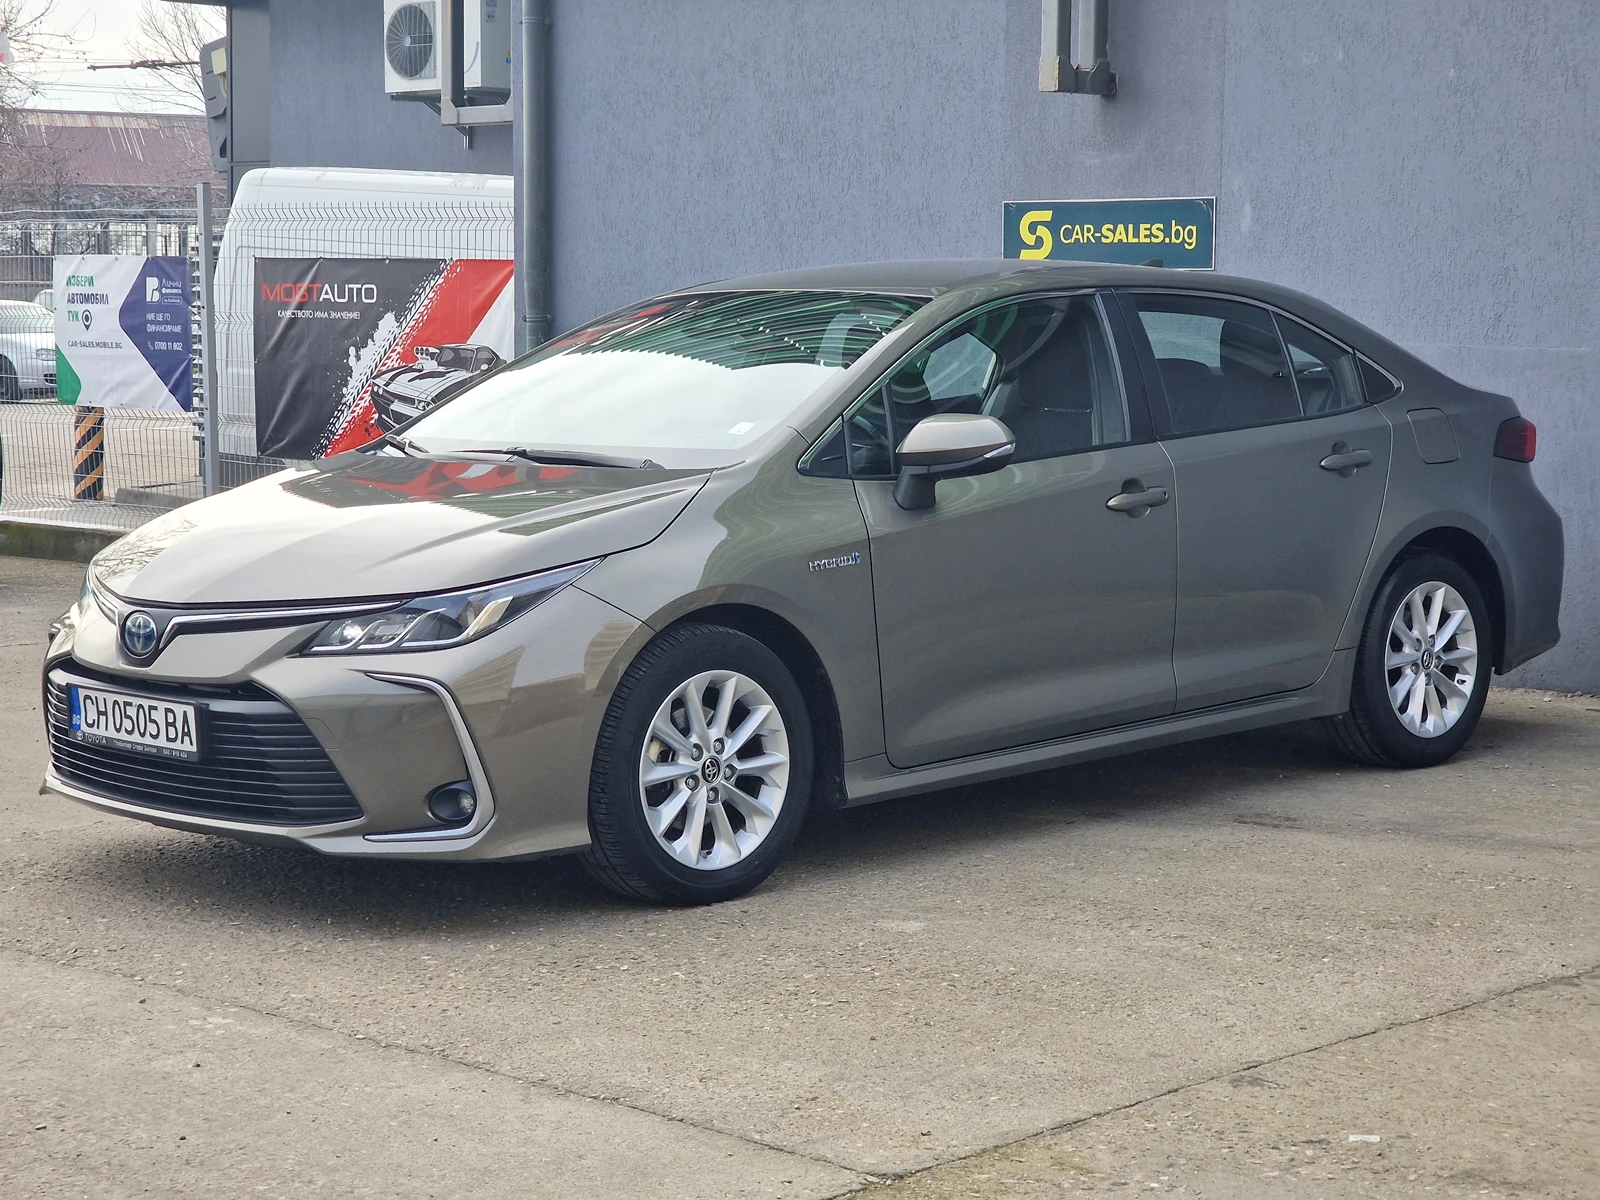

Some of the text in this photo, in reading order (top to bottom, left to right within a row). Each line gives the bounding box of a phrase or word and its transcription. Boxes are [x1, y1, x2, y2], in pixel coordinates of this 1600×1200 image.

[1059, 219, 1198, 250] CAR-SALES.bg
[66, 275, 94, 287] ИЗБЕРИ
[67, 293, 109, 305] АВТОМОБИЛ
[263, 284, 377, 304] MOSTAUTO
[67, 310, 80, 322] ТУК
[278, 310, 314, 319] КАЧЕСТВОТО
[314, 311, 329, 319] ИМА
[67, 340, 123, 350] CAR-SALES.MOBILE.BG
[154, 341, 167, 350] 0700
[167, 342, 172, 350] 11
[808, 555, 852, 572] HYBRID
[73, 714, 81, 725] BG
[85, 734, 107, 745] TOYOTA
